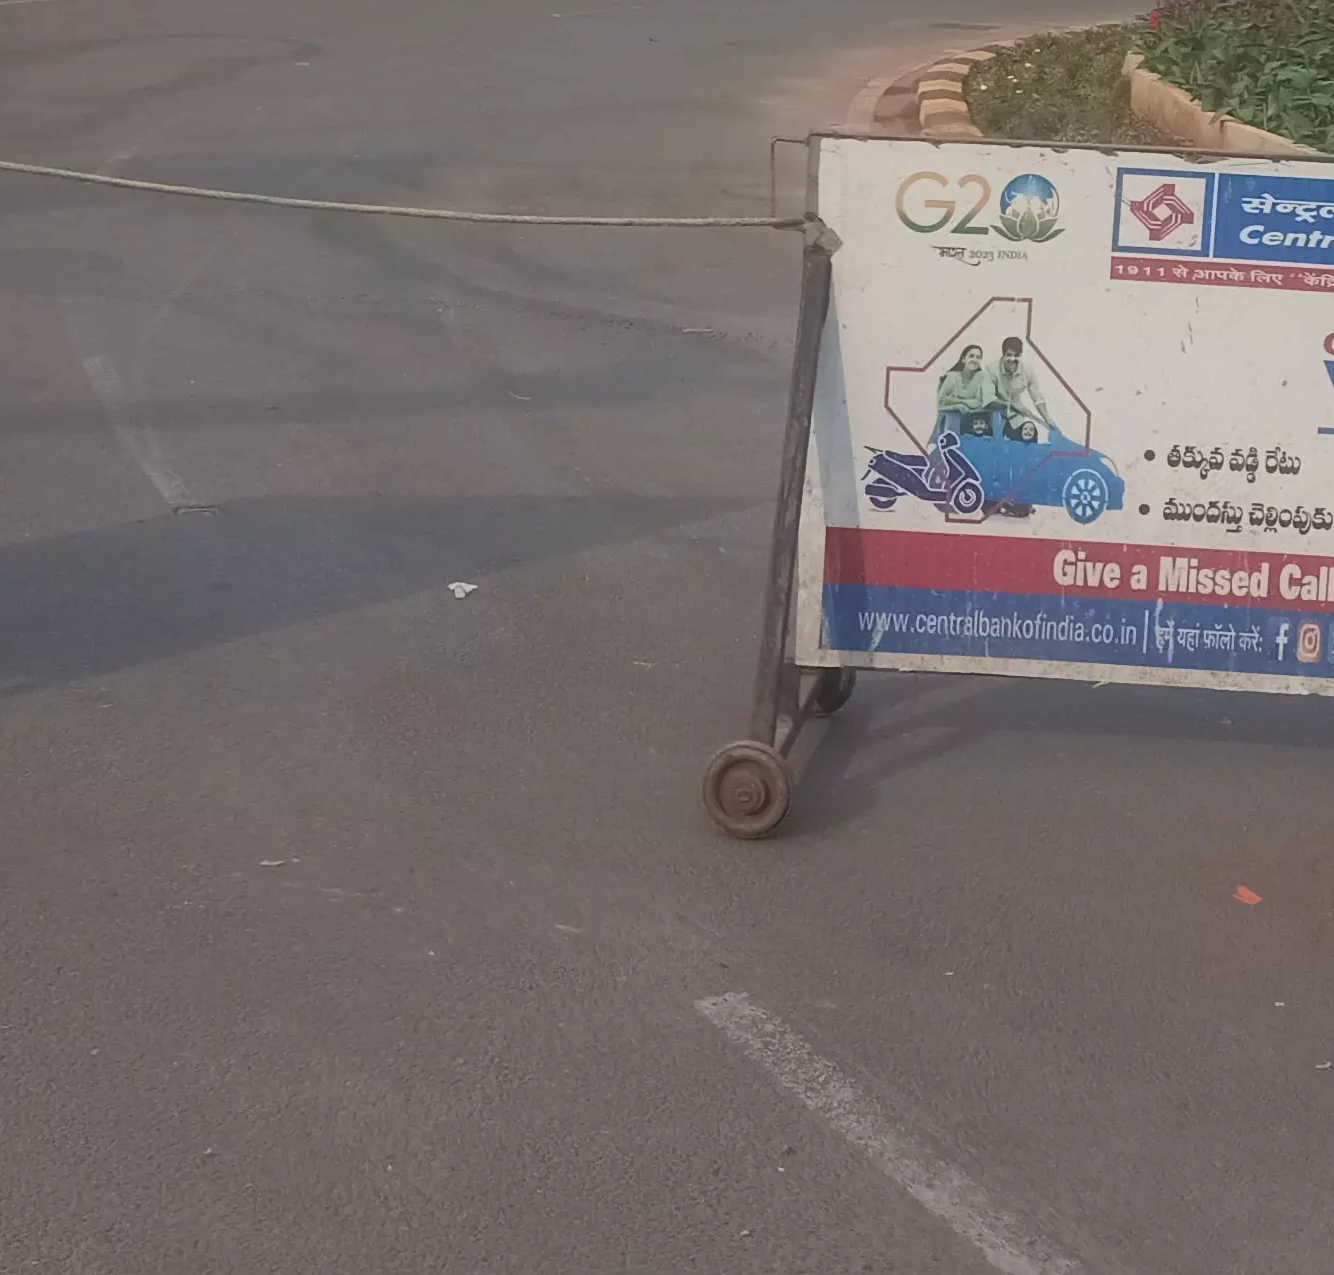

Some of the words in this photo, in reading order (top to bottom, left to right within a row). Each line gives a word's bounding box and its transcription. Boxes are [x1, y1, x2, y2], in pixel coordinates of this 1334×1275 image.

[997, 250, 1028, 260] INDIA
[1172, 265, 1190, 279] से
[1192, 267, 1245, 282] आपके
[1250, 270, 1284, 285] लिए
[1167, 444, 1225, 480] తక్కువ
[1265, 446, 1302, 475] రేటు
[1162, 497, 1244, 533] ముందస్తు
[1248, 502, 1334, 535] చెల్లింపుకు
[1053, 549, 1121, 590] Give
[1130, 563, 1147, 590] a
[1158, 555, 1268, 598] Missed
[858, 609, 1138, 645] www.centralbankofindia.co.in
